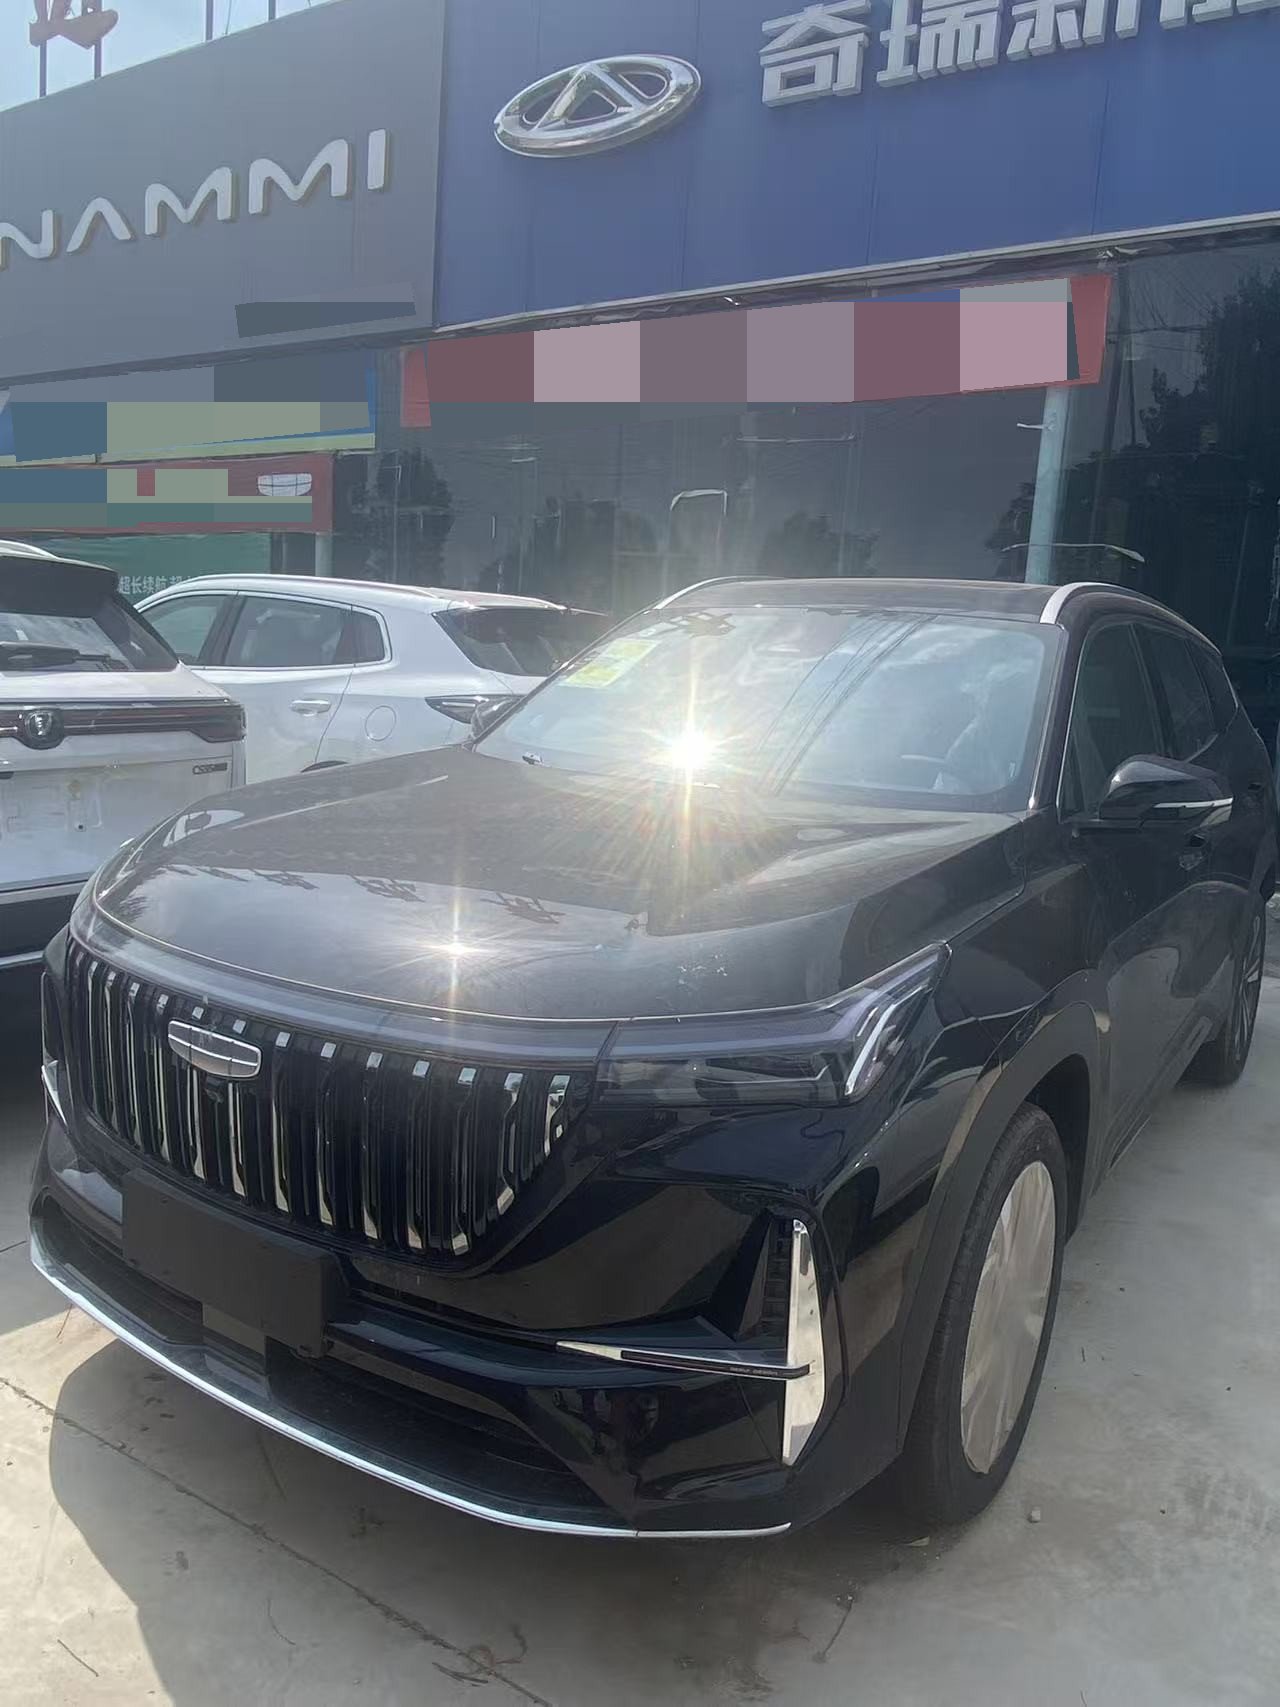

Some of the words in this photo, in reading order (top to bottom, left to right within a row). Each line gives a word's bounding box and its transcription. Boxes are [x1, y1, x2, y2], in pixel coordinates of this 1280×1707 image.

[759, 0, 1280, 107] 奇瑞新
[0, 128, 387, 271] NAMMI
